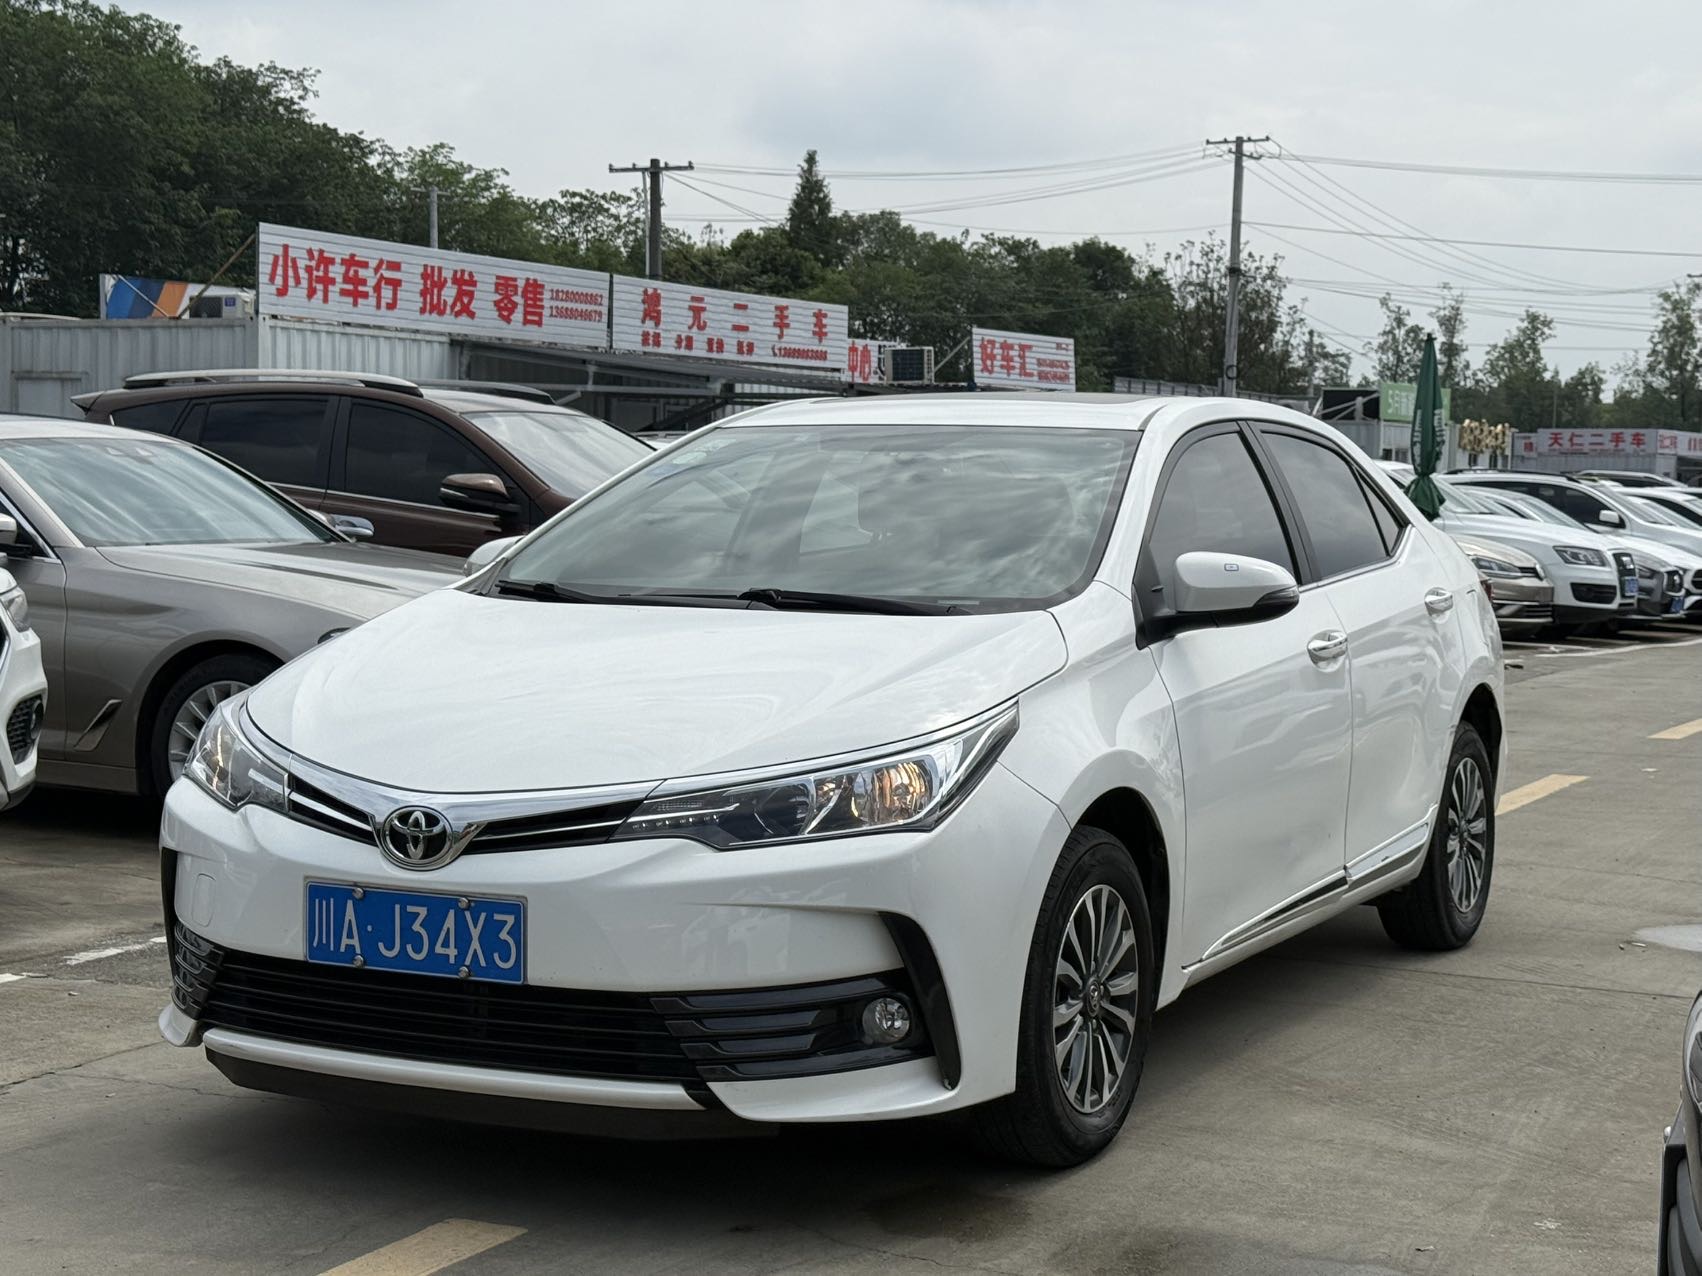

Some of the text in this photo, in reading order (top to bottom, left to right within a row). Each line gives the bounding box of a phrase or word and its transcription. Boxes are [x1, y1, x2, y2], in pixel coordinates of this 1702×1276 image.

[268, 243, 545, 328] 小许车行 批发 零售
[1549, 431, 1646, 448] 天仁二手车
